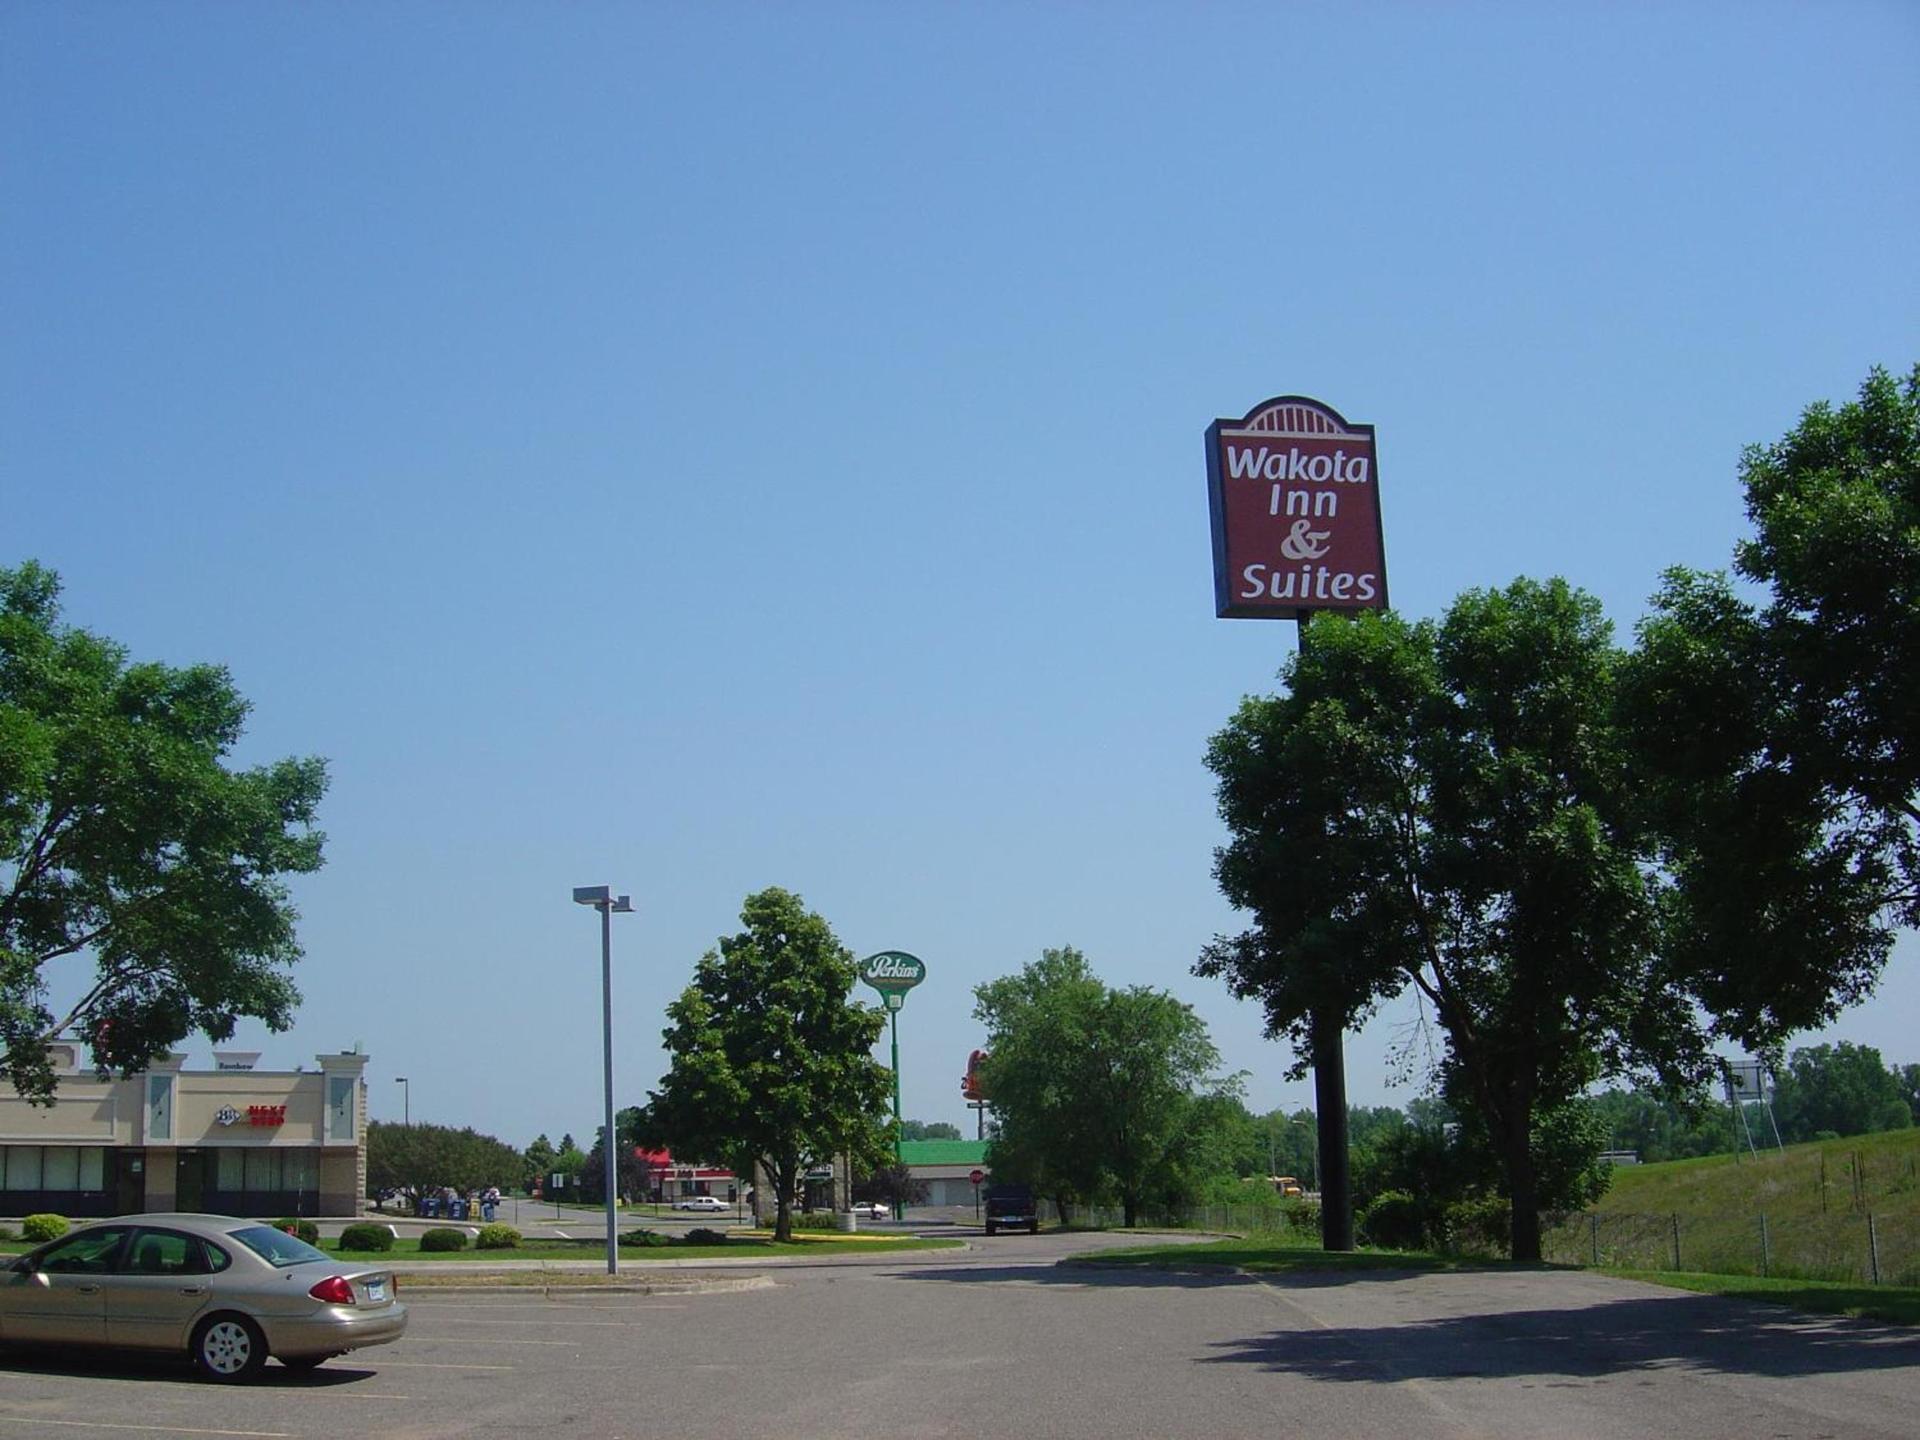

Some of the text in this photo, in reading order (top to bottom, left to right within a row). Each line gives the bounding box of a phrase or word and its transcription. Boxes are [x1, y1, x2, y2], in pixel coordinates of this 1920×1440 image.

[1226, 445, 1369, 483] Wakota
[1269, 483, 1337, 517] Inn
[1280, 519, 1331, 560] &
[1240, 563, 1376, 601] Suites
[867, 955, 919, 978] Perkins
